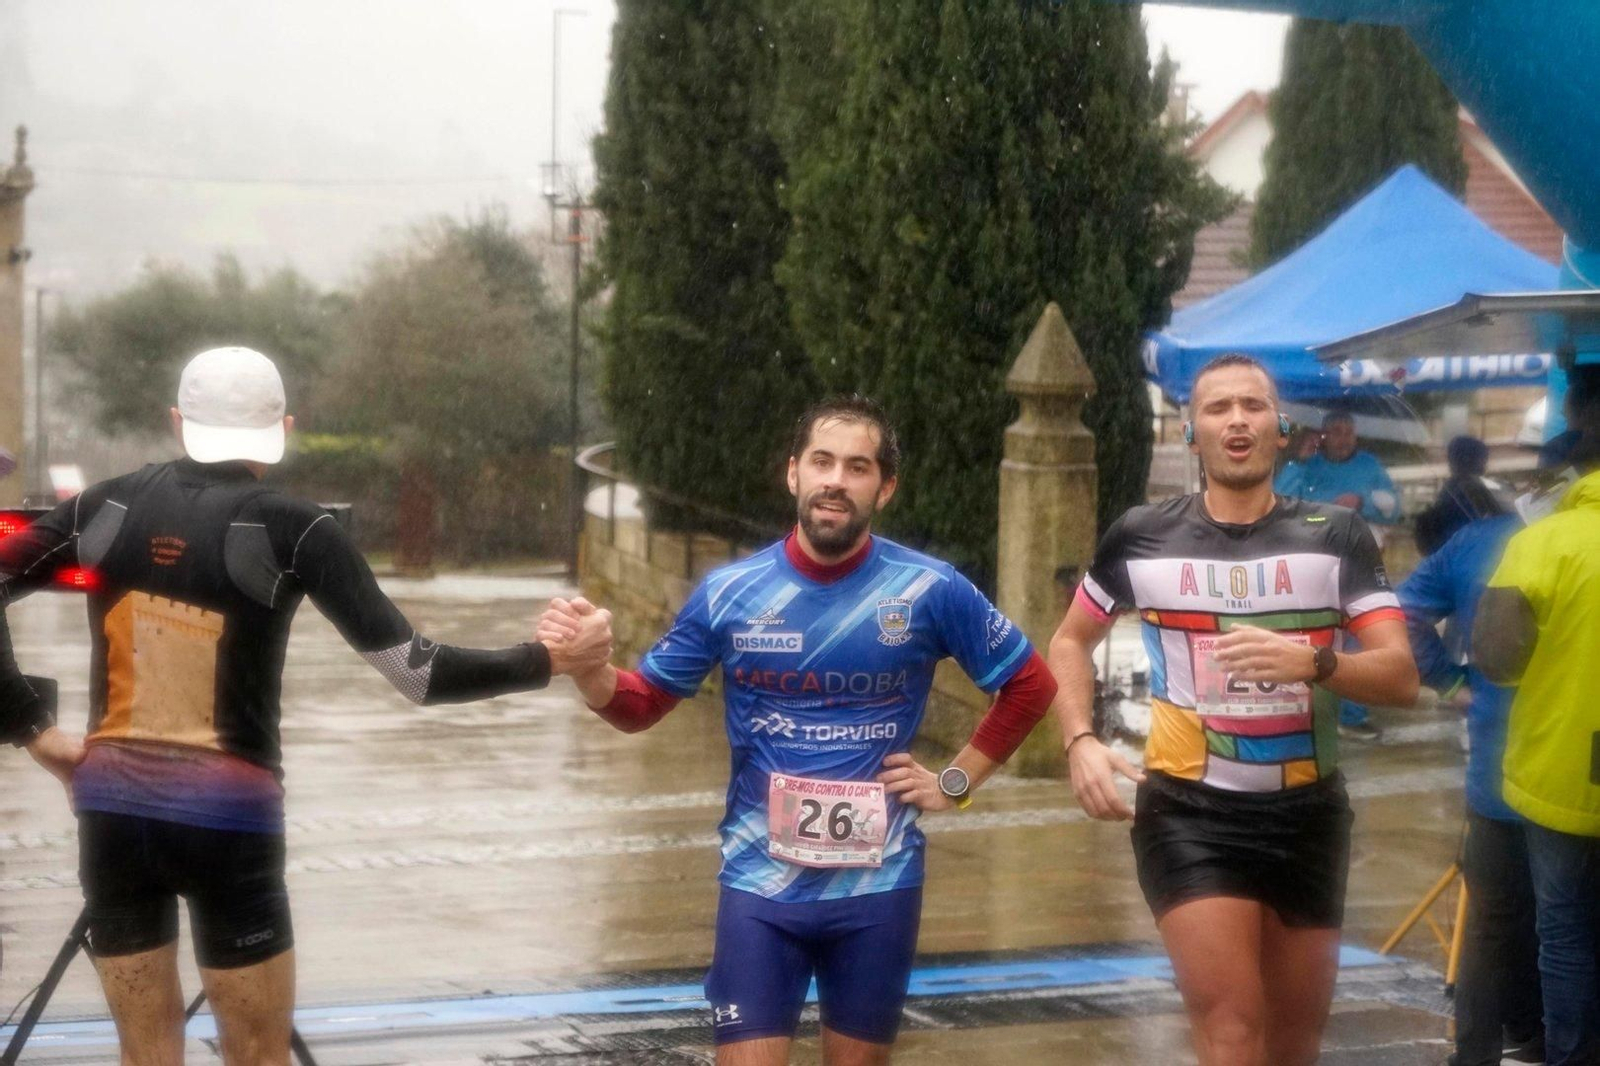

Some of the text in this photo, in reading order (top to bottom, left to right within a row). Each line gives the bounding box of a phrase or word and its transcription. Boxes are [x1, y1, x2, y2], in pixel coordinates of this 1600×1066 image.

[1179, 559, 1294, 600] ALOIA
[877, 598, 914, 607] ATLETISMO
[1225, 600, 1253, 609] TRAIL
[745, 618, 787, 626] MERCURY
[734, 637, 798, 650] DISMAC
[801, 722, 898, 742] TORVIGO
[815, 784, 847, 797] CONTRA
[797, 799, 853, 841] 26
